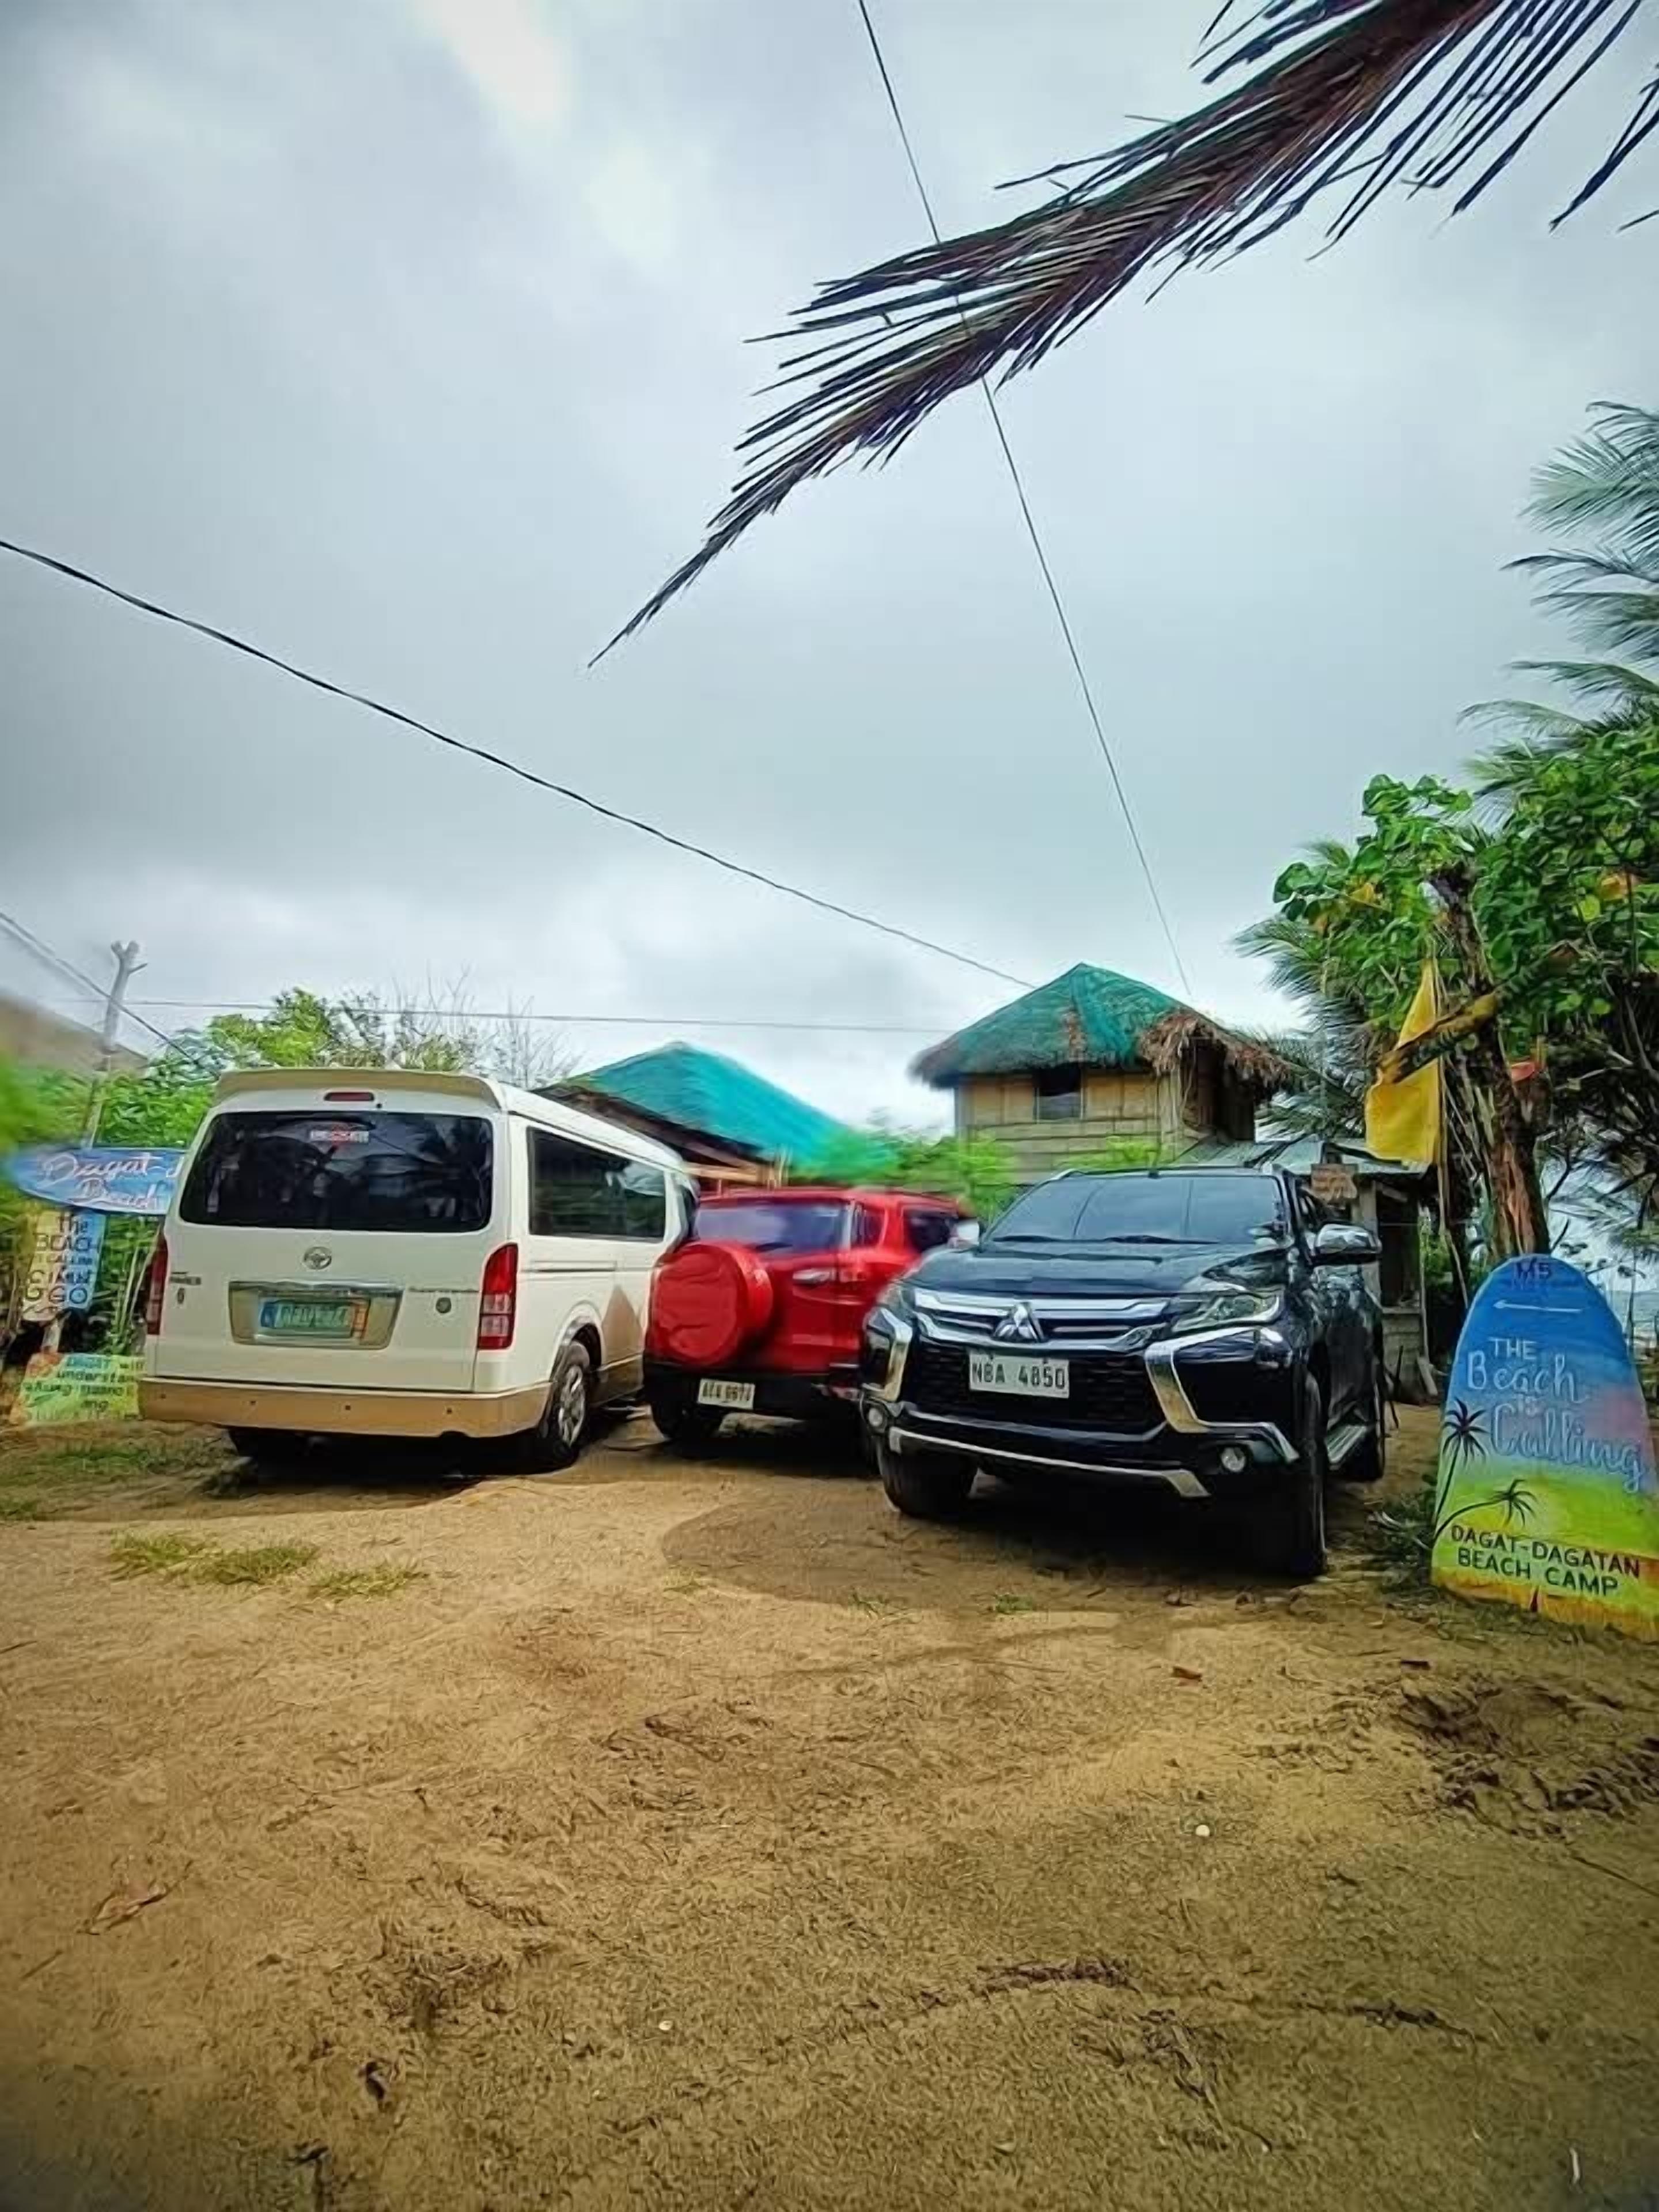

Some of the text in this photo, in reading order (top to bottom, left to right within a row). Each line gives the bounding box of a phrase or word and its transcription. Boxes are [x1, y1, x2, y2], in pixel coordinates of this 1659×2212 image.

[972, 1363, 1005, 1384] NBA
[1488, 1336, 1537, 1360] THE
[1468, 1350, 1590, 1403] Beach
[1491, 1402, 1641, 1494] Calling
[1450, 1524, 1641, 1580] DAGAT-DAGATAN
[1457, 1546, 1619, 1596] BEACH CAMP
